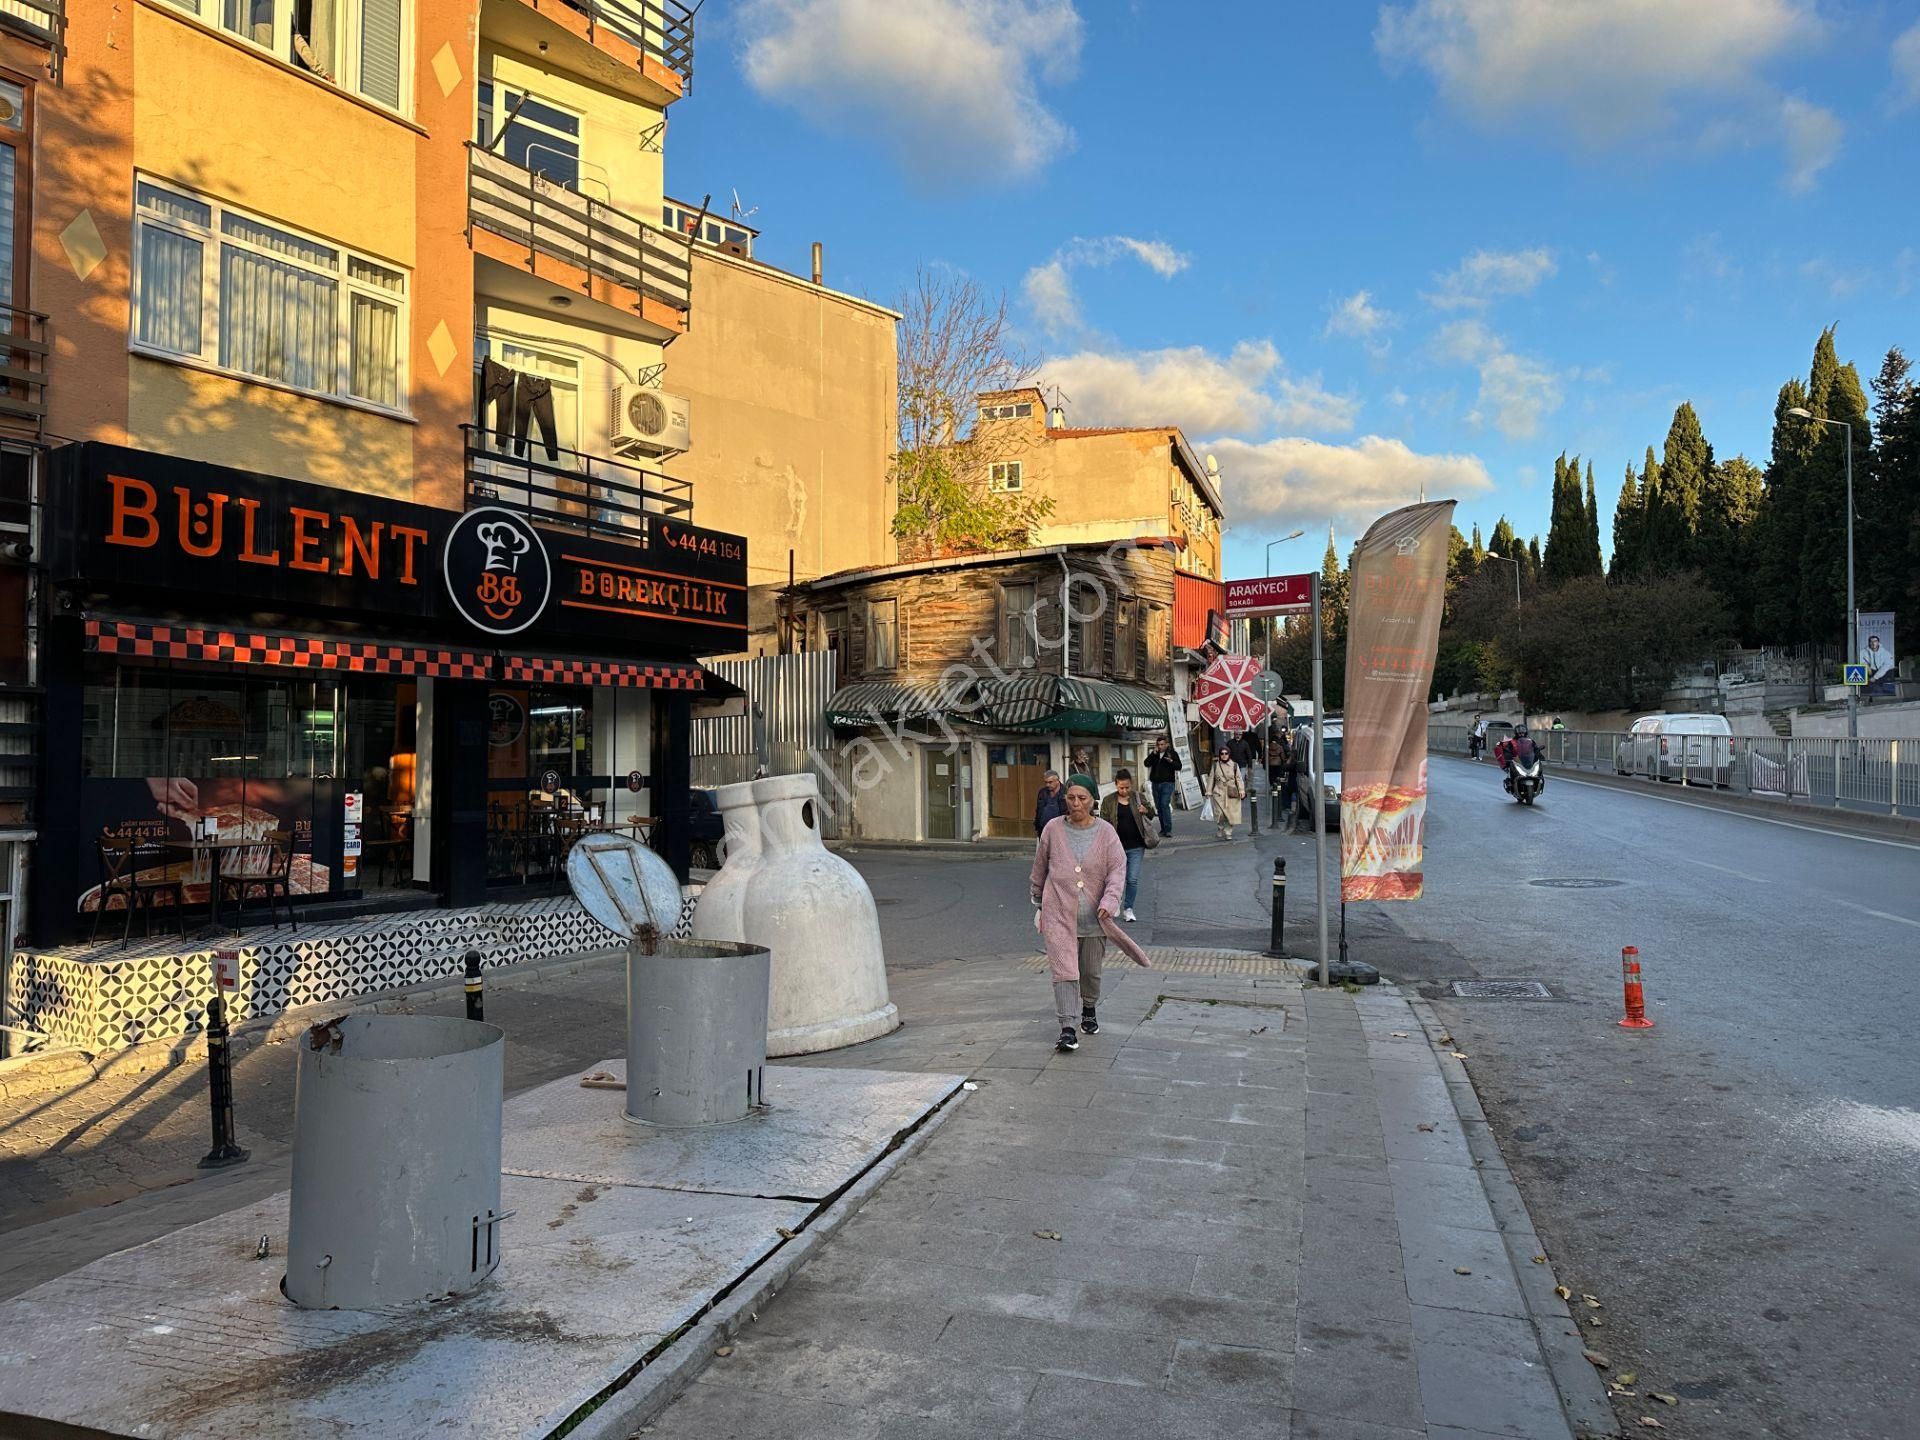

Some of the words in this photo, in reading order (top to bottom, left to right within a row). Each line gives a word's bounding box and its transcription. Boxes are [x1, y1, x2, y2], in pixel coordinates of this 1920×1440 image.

[104, 474, 428, 585] BÜLENT
[679, 533, 697, 552] 44
[699, 538, 717, 556] 44
[720, 542, 741, 561] 164
[579, 569, 728, 615] BÖREKÇİLİK
[1229, 580, 1288, 598] ARAKİYECİ
[1229, 599, 1254, 607] SOKAĞI
